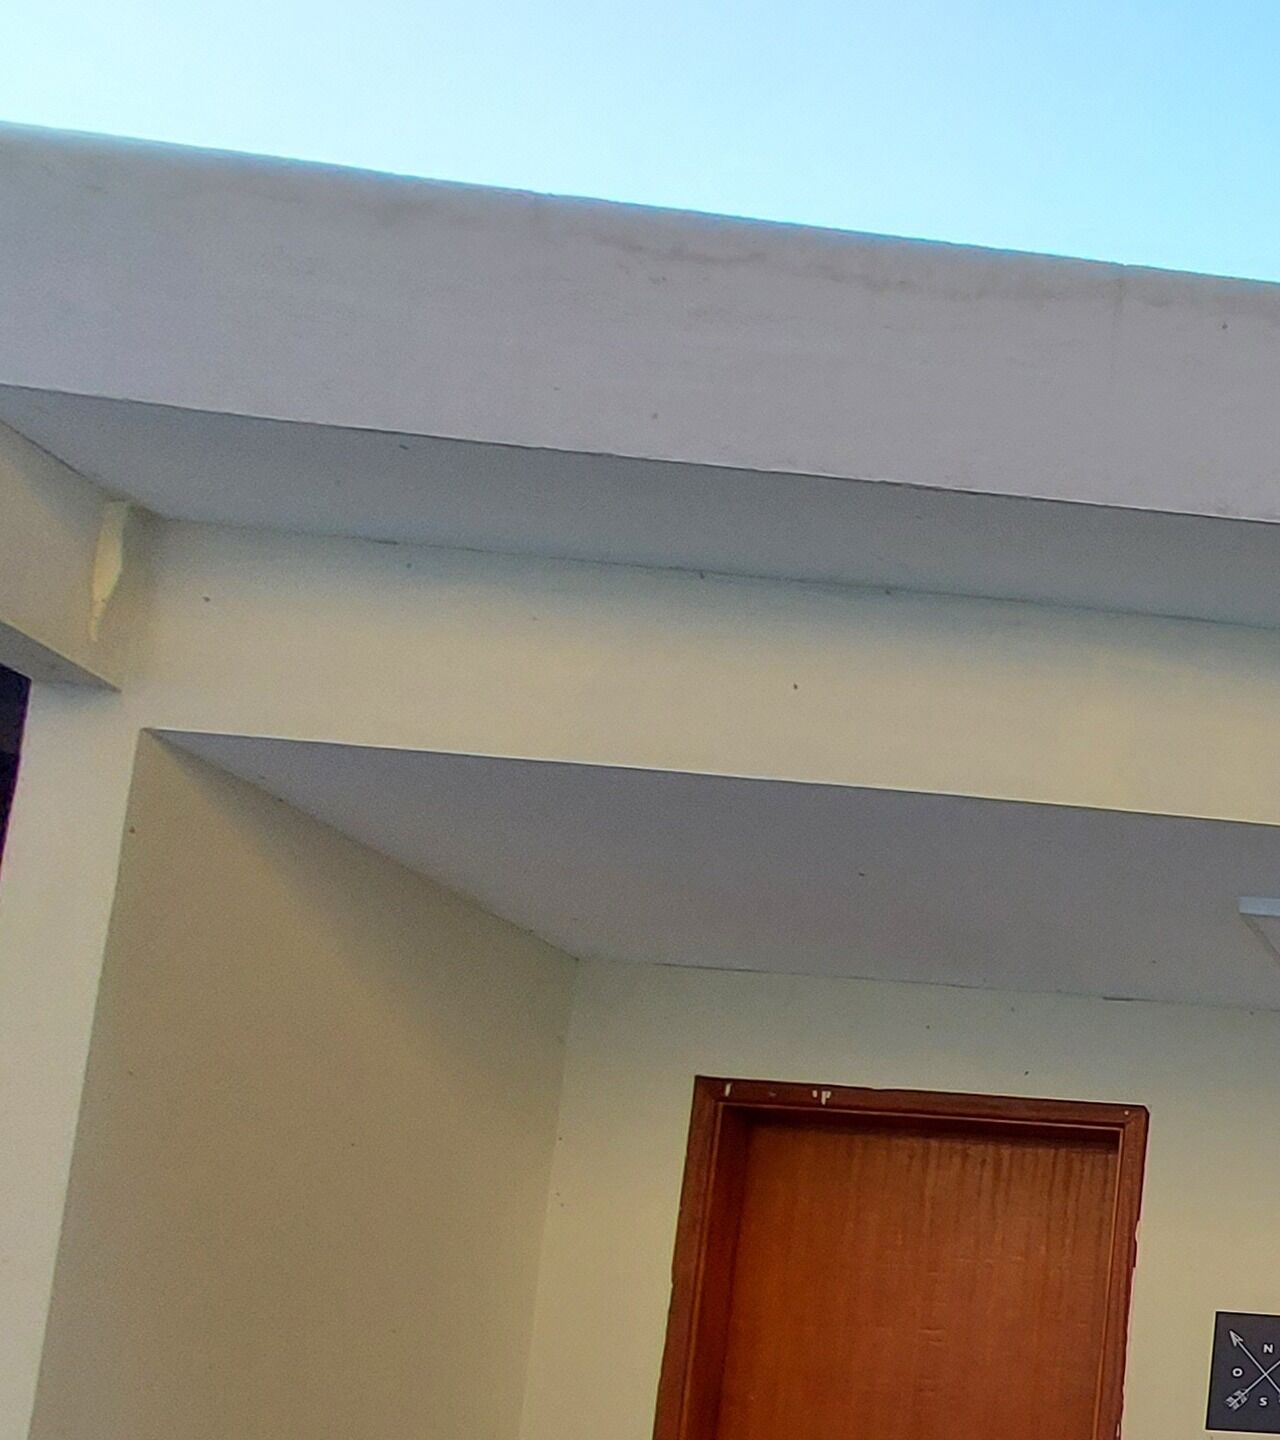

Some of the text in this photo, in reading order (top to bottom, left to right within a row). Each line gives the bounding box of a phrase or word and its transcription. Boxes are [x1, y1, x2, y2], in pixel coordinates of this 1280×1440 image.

[1263, 1343, 1274, 1354] N
[1232, 1367, 1244, 1377] O
[1259, 1397, 1268, 1407] S
